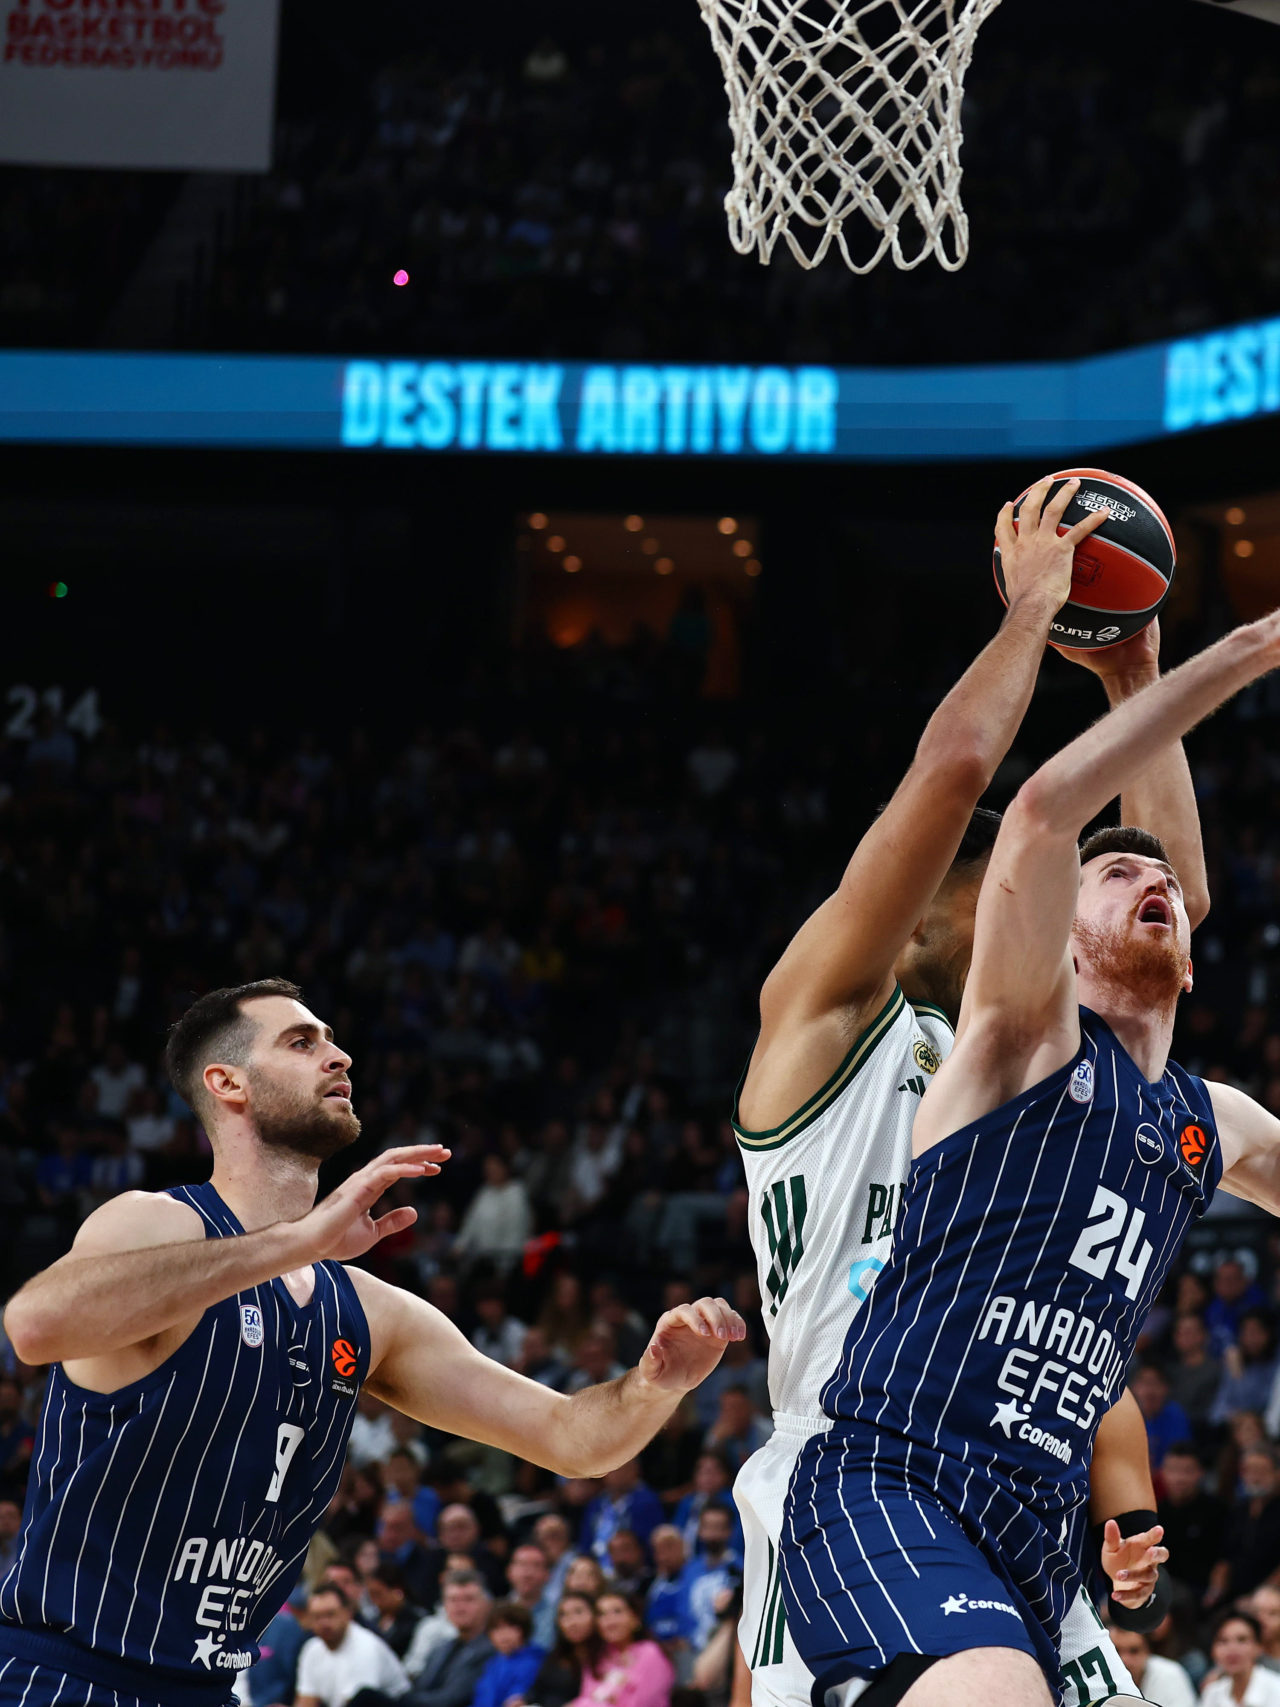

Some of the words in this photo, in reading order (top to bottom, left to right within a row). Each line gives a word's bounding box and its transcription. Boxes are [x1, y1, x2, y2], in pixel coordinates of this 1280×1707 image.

[341, 361, 565, 449] DESTEK
[577, 366, 839, 453] ARTIYOR
[1138, 1133, 1162, 1153] GSA
[1068, 1184, 1154, 1301] 24
[997, 1347, 1103, 1430] EFES
[265, 1422, 306, 1503] 9
